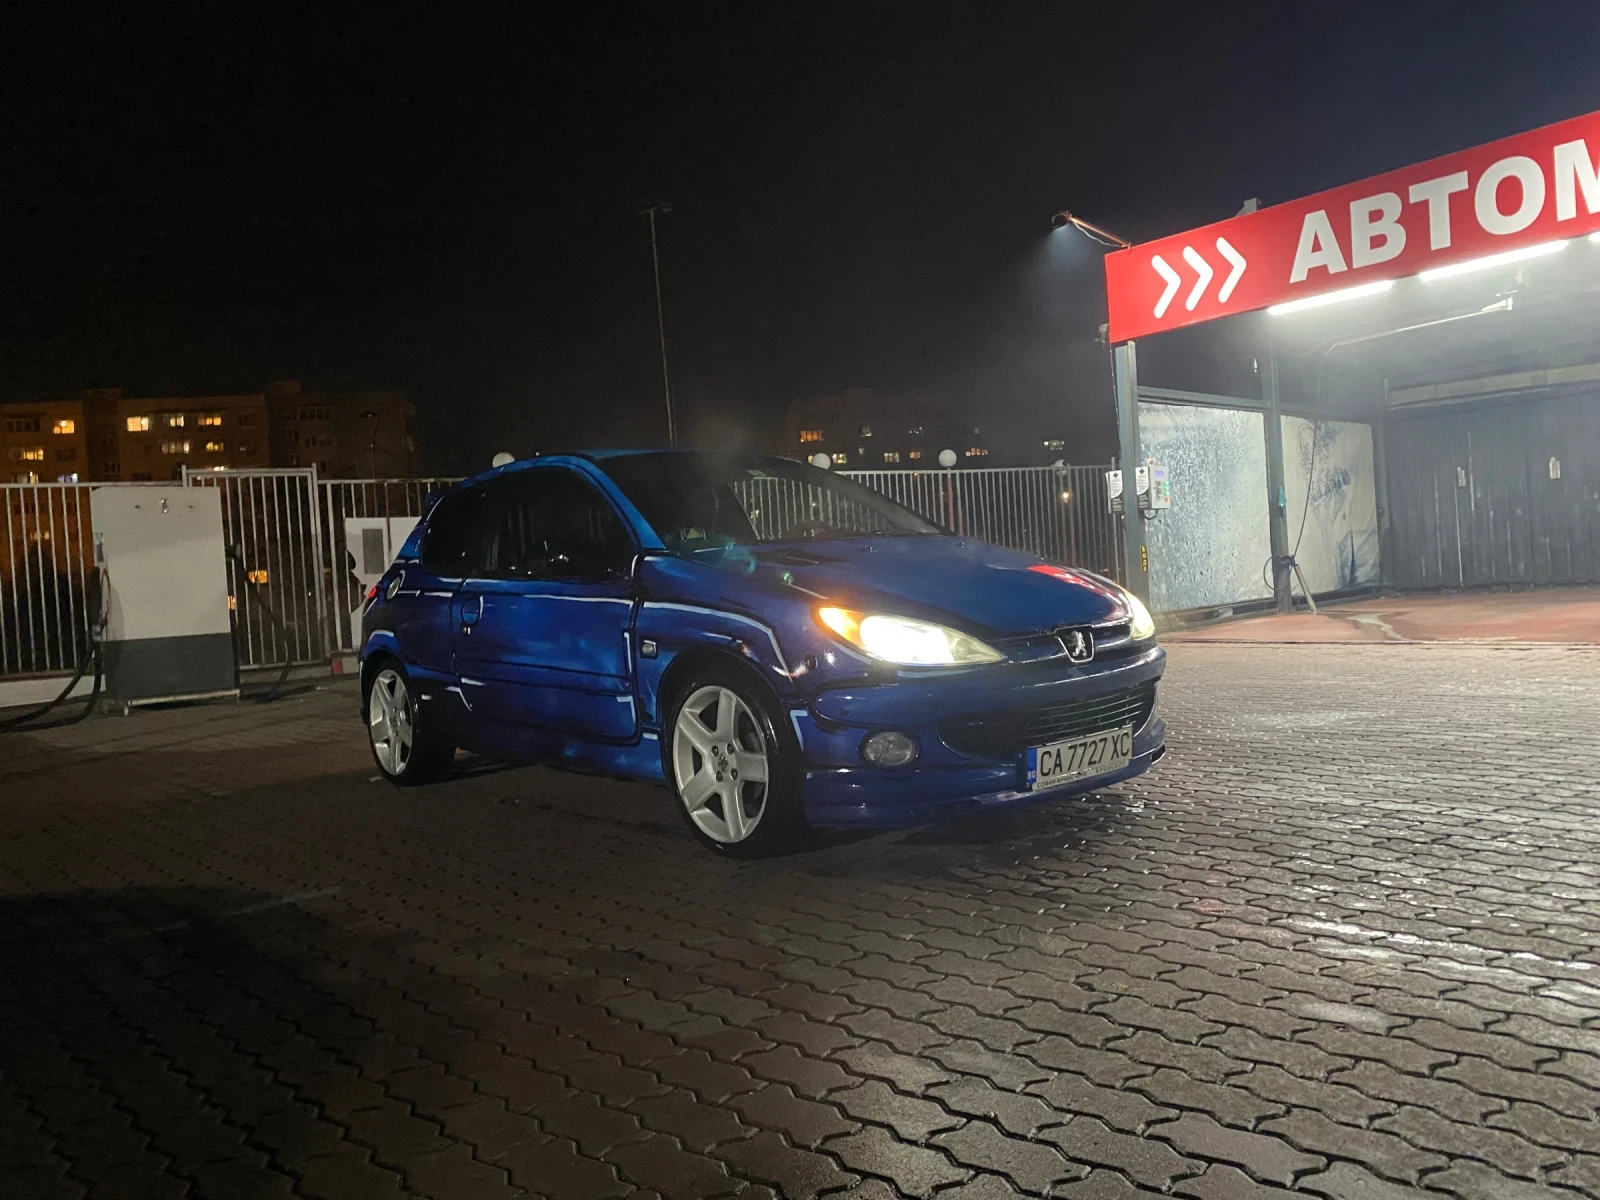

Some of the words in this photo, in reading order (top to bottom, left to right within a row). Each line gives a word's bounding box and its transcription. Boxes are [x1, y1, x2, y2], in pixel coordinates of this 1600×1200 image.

[1289, 139, 1600, 284] АВТОМ
[1027, 771, 1036, 780] BG
[1041, 748, 1062, 777] CA
[1068, 738, 1107, 771] 7727
[1110, 732, 1130, 761] XC
